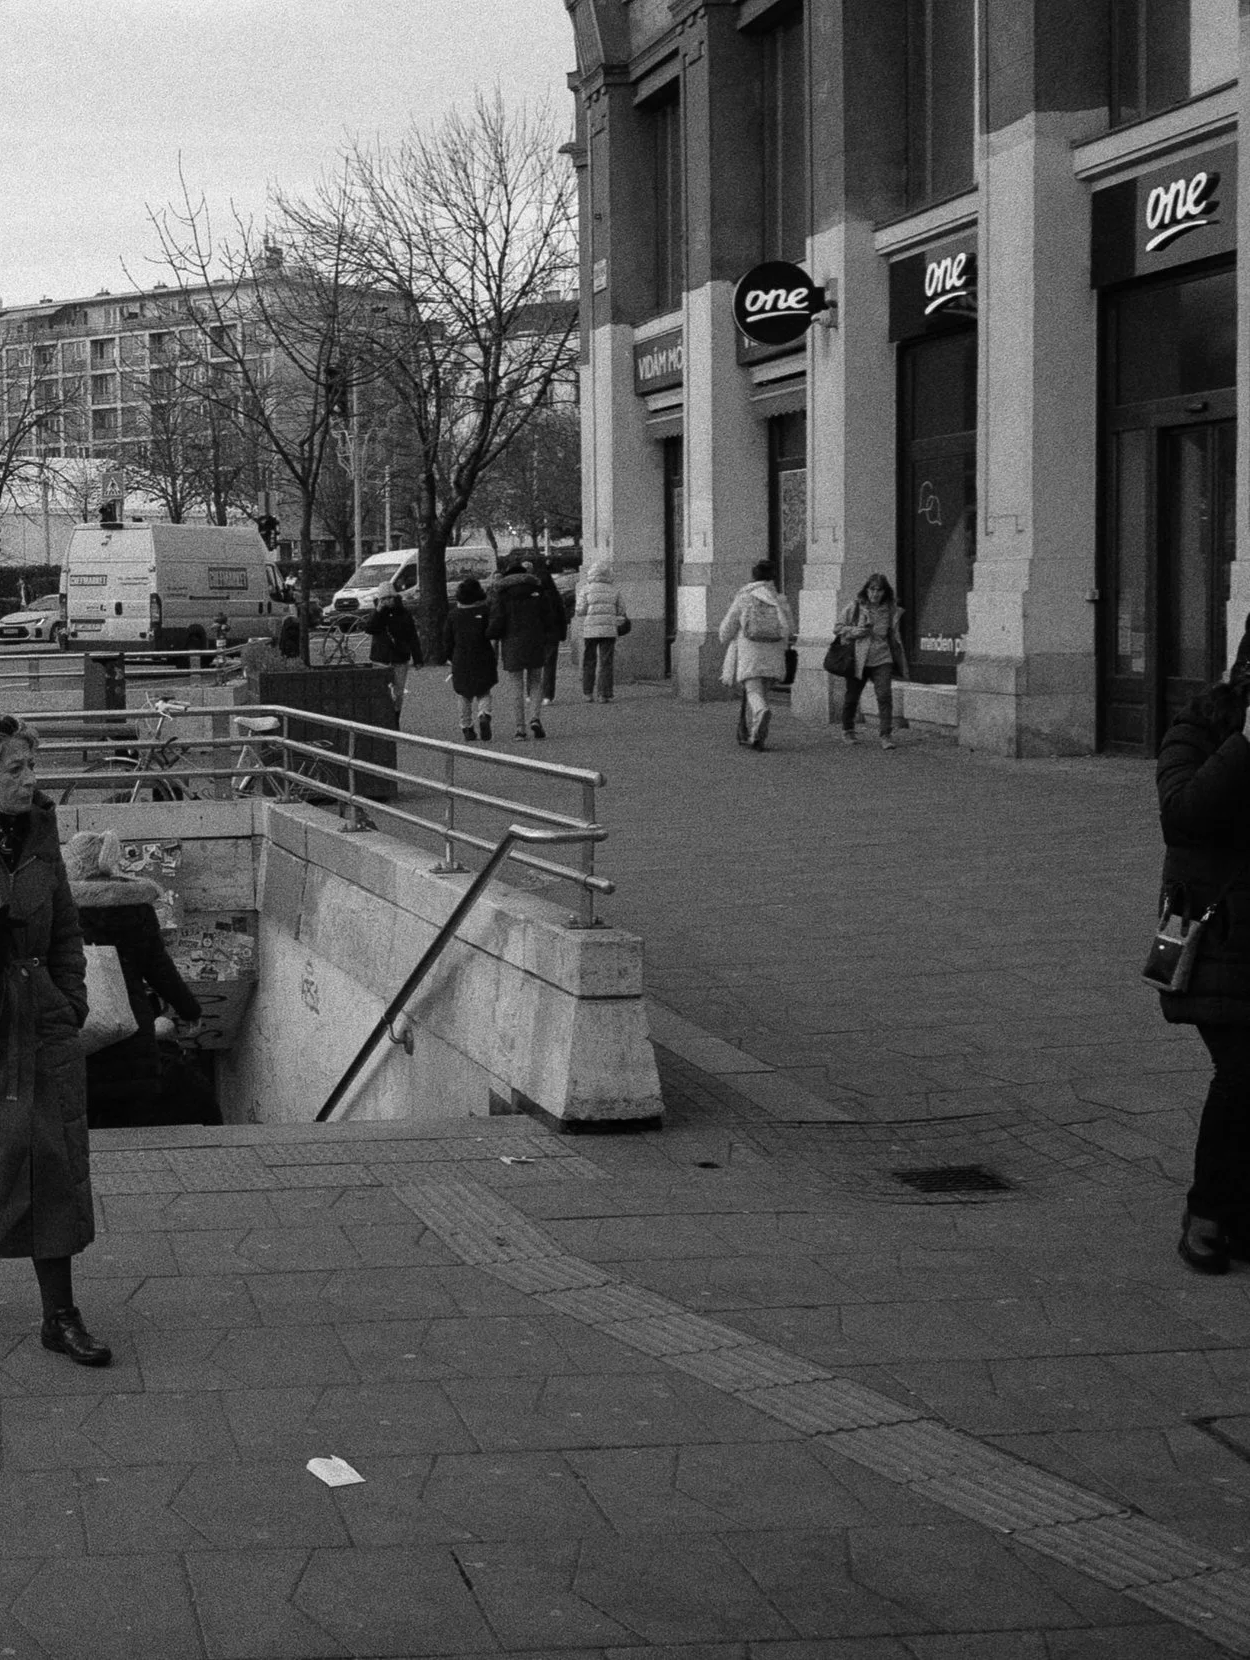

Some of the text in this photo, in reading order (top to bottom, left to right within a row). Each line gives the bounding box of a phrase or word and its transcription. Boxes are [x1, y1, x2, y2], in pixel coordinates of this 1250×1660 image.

[1146, 172, 1207, 230] one
[924, 253, 967, 297] one
[745, 287, 809, 312] one
[920, 632, 953, 651] minden
